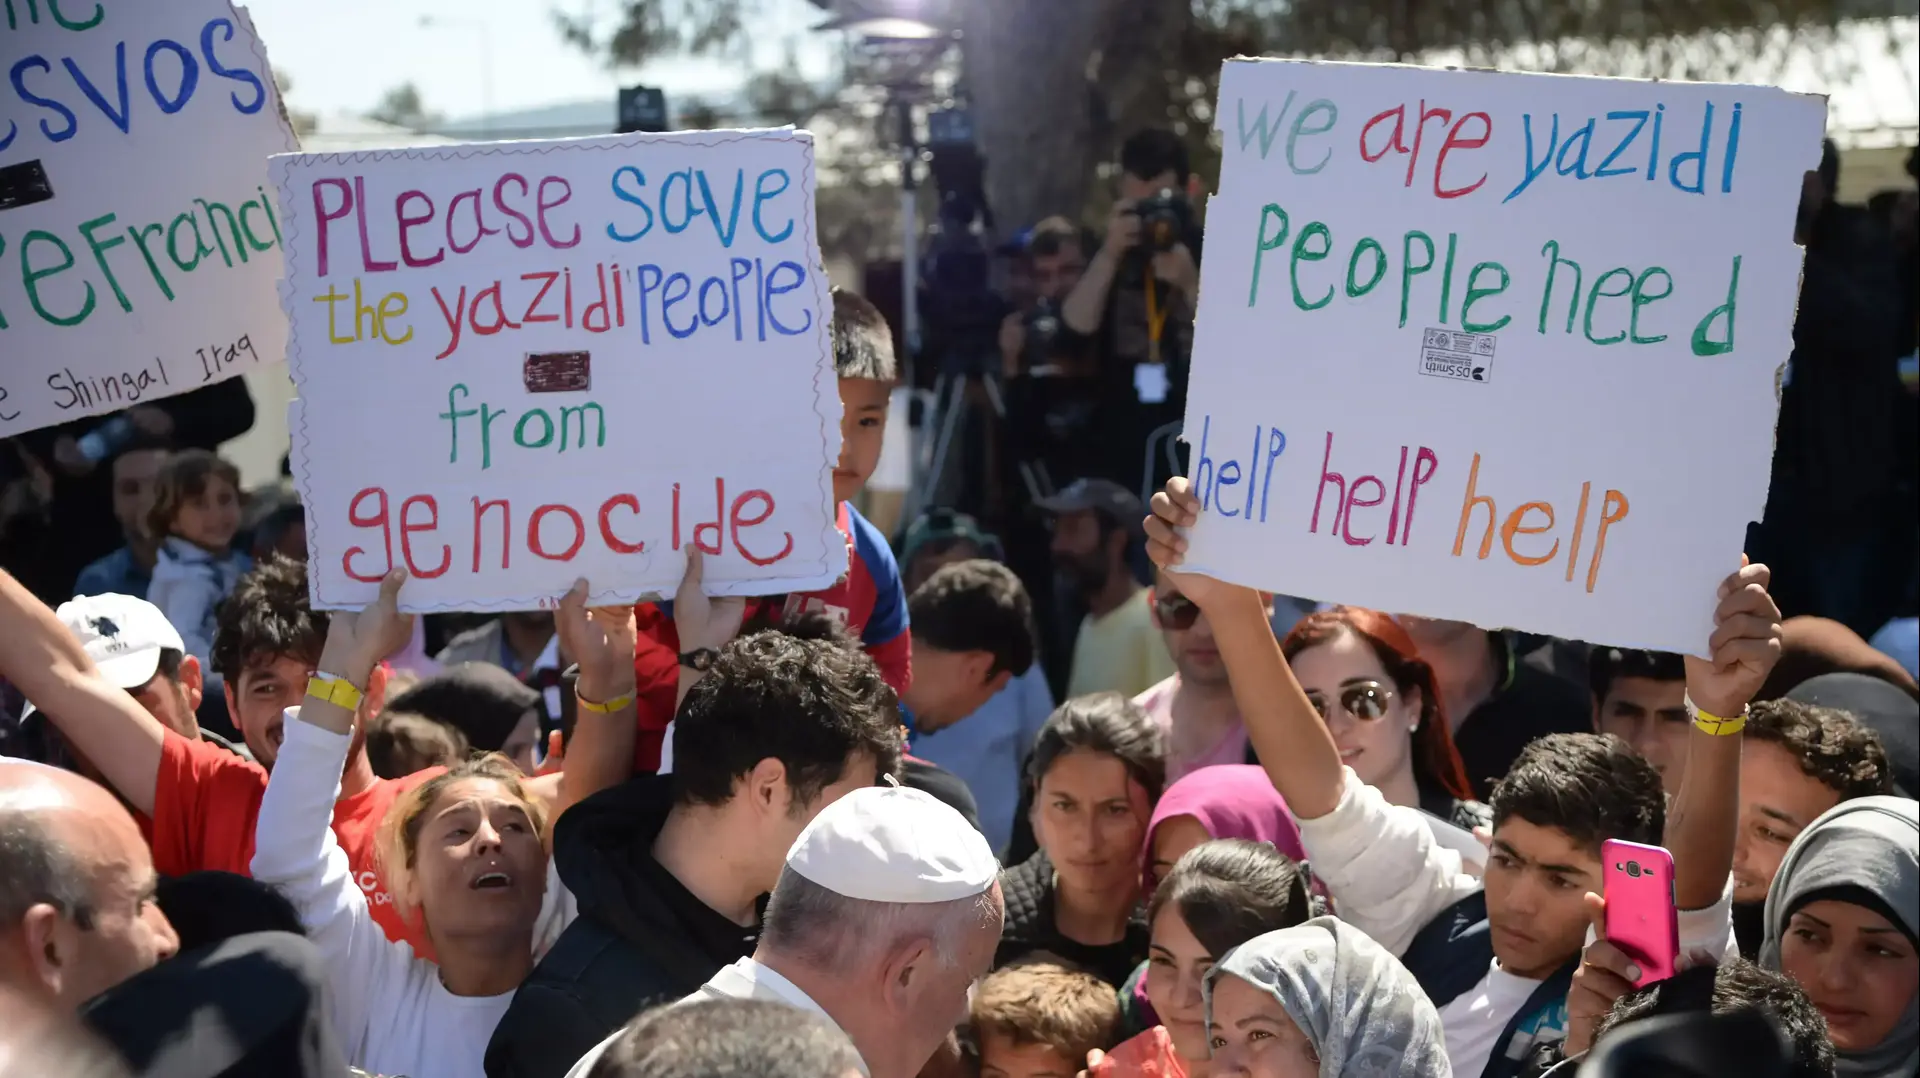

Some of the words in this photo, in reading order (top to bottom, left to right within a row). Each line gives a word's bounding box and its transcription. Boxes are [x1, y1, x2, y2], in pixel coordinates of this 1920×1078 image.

[0, 18, 265, 151] SVOS
[1360, 100, 1492, 200] are
[1503, 101, 1743, 204] yazidi
[607, 165, 794, 248] save
[313, 279, 413, 346] the
[431, 262, 625, 361] yazidi
[1538, 240, 1742, 357] need
[47, 367, 169, 409] Shingal
[196, 333, 259, 382] Iraq
[1426, 361, 1456, 376] Smith
[1456, 365, 1471, 378] DS
[440, 383, 606, 469] from
[342, 477, 794, 583] genocide
